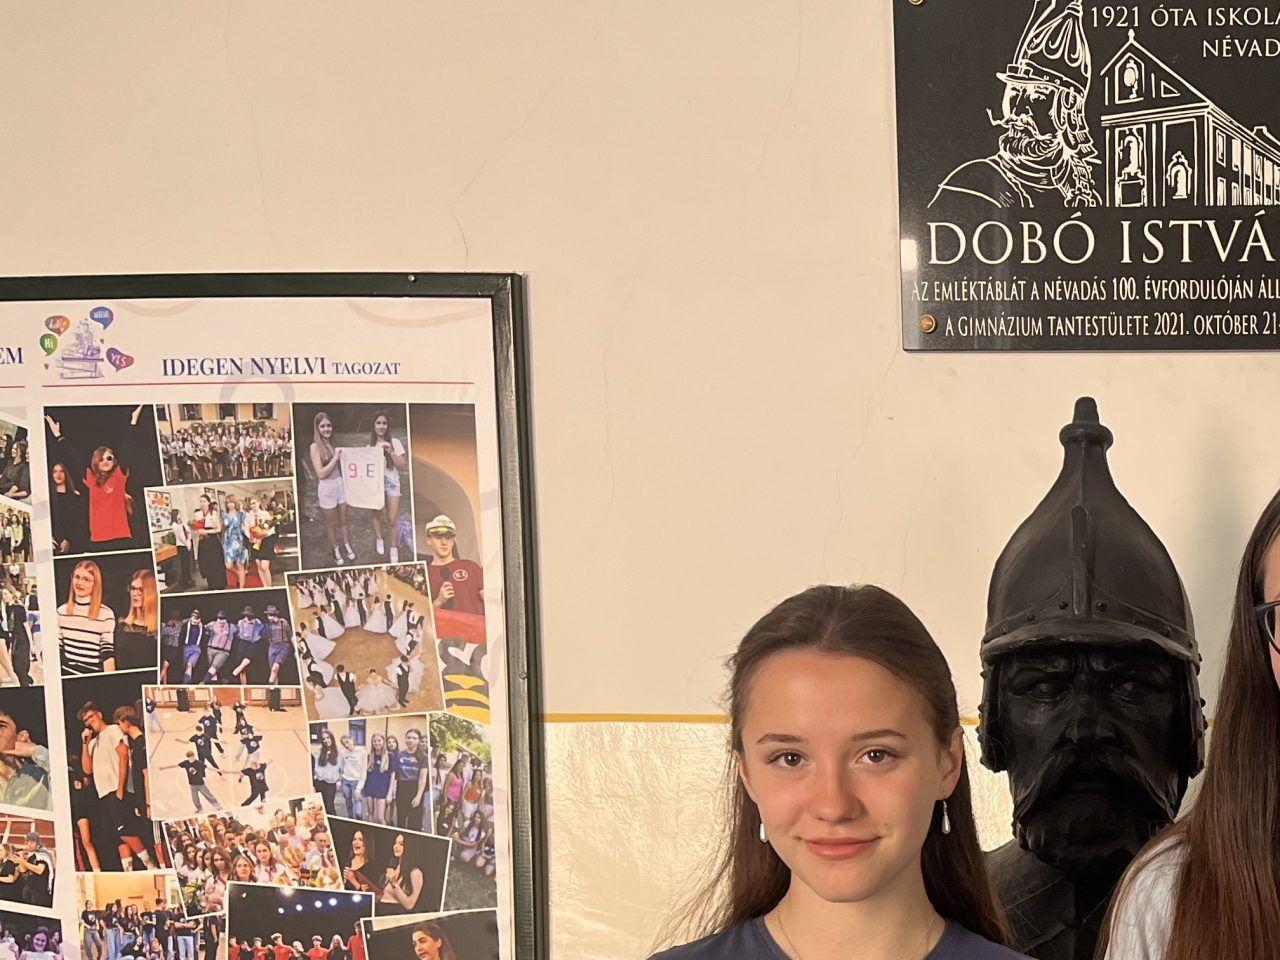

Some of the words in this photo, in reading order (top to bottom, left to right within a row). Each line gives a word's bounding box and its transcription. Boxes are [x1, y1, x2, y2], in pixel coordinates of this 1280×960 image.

[1091, 6, 1140, 28] 1921
[1151, 5, 1197, 27] ÓTA
[927, 212, 1096, 266] DOBÓ
[911, 281, 929, 301] AZ
[933, 277, 1025, 302] EMLÉKTÁBLÁT
[1030, 281, 1041, 301] A
[1044, 277, 1107, 301] NÉVADÁS
[1112, 280, 1139, 300] 100.
[1144, 275, 1254, 303] ÉVFORDULÓJÁN
[945, 317, 955, 336] A
[958, 313, 1043, 337] GIMNÁZIUM
[1047, 313, 1151, 337] TANTESTÜLETE
[1153, 315, 1190, 336] 2021.
[1193, 312, 1259, 336] OKTÓBER
[111, 353, 126, 366] YES
[161, 357, 243, 377] IDEGEN
[250, 356, 327, 375] NYELVI
[332, 362, 400, 376] TAGOZAT
